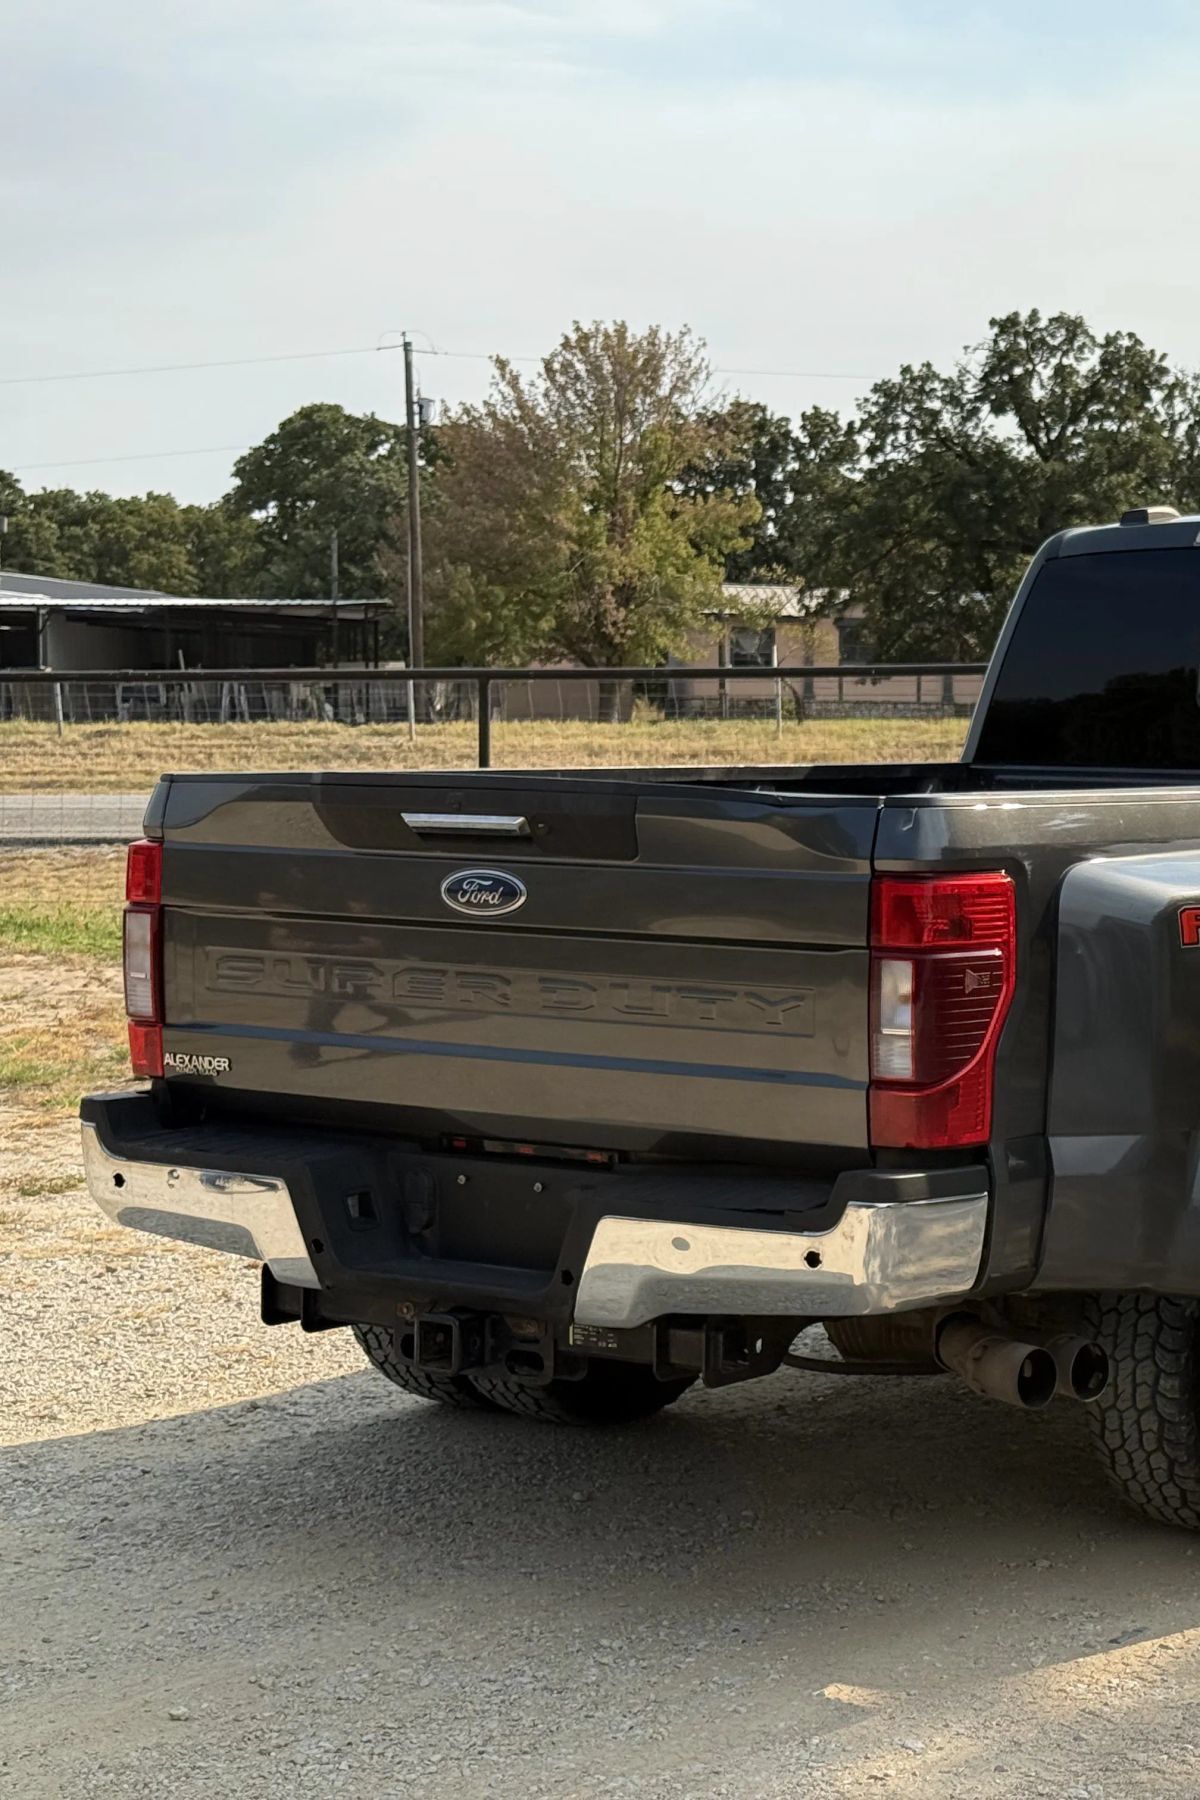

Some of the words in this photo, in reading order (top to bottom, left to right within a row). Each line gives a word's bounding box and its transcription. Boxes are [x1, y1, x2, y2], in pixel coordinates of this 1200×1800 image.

[457, 878, 504, 905] Ford
[214, 953, 514, 1007] SUPER
[537, 976, 806, 1025] DUTY
[164, 1053, 230, 1072] ALEXANDER
